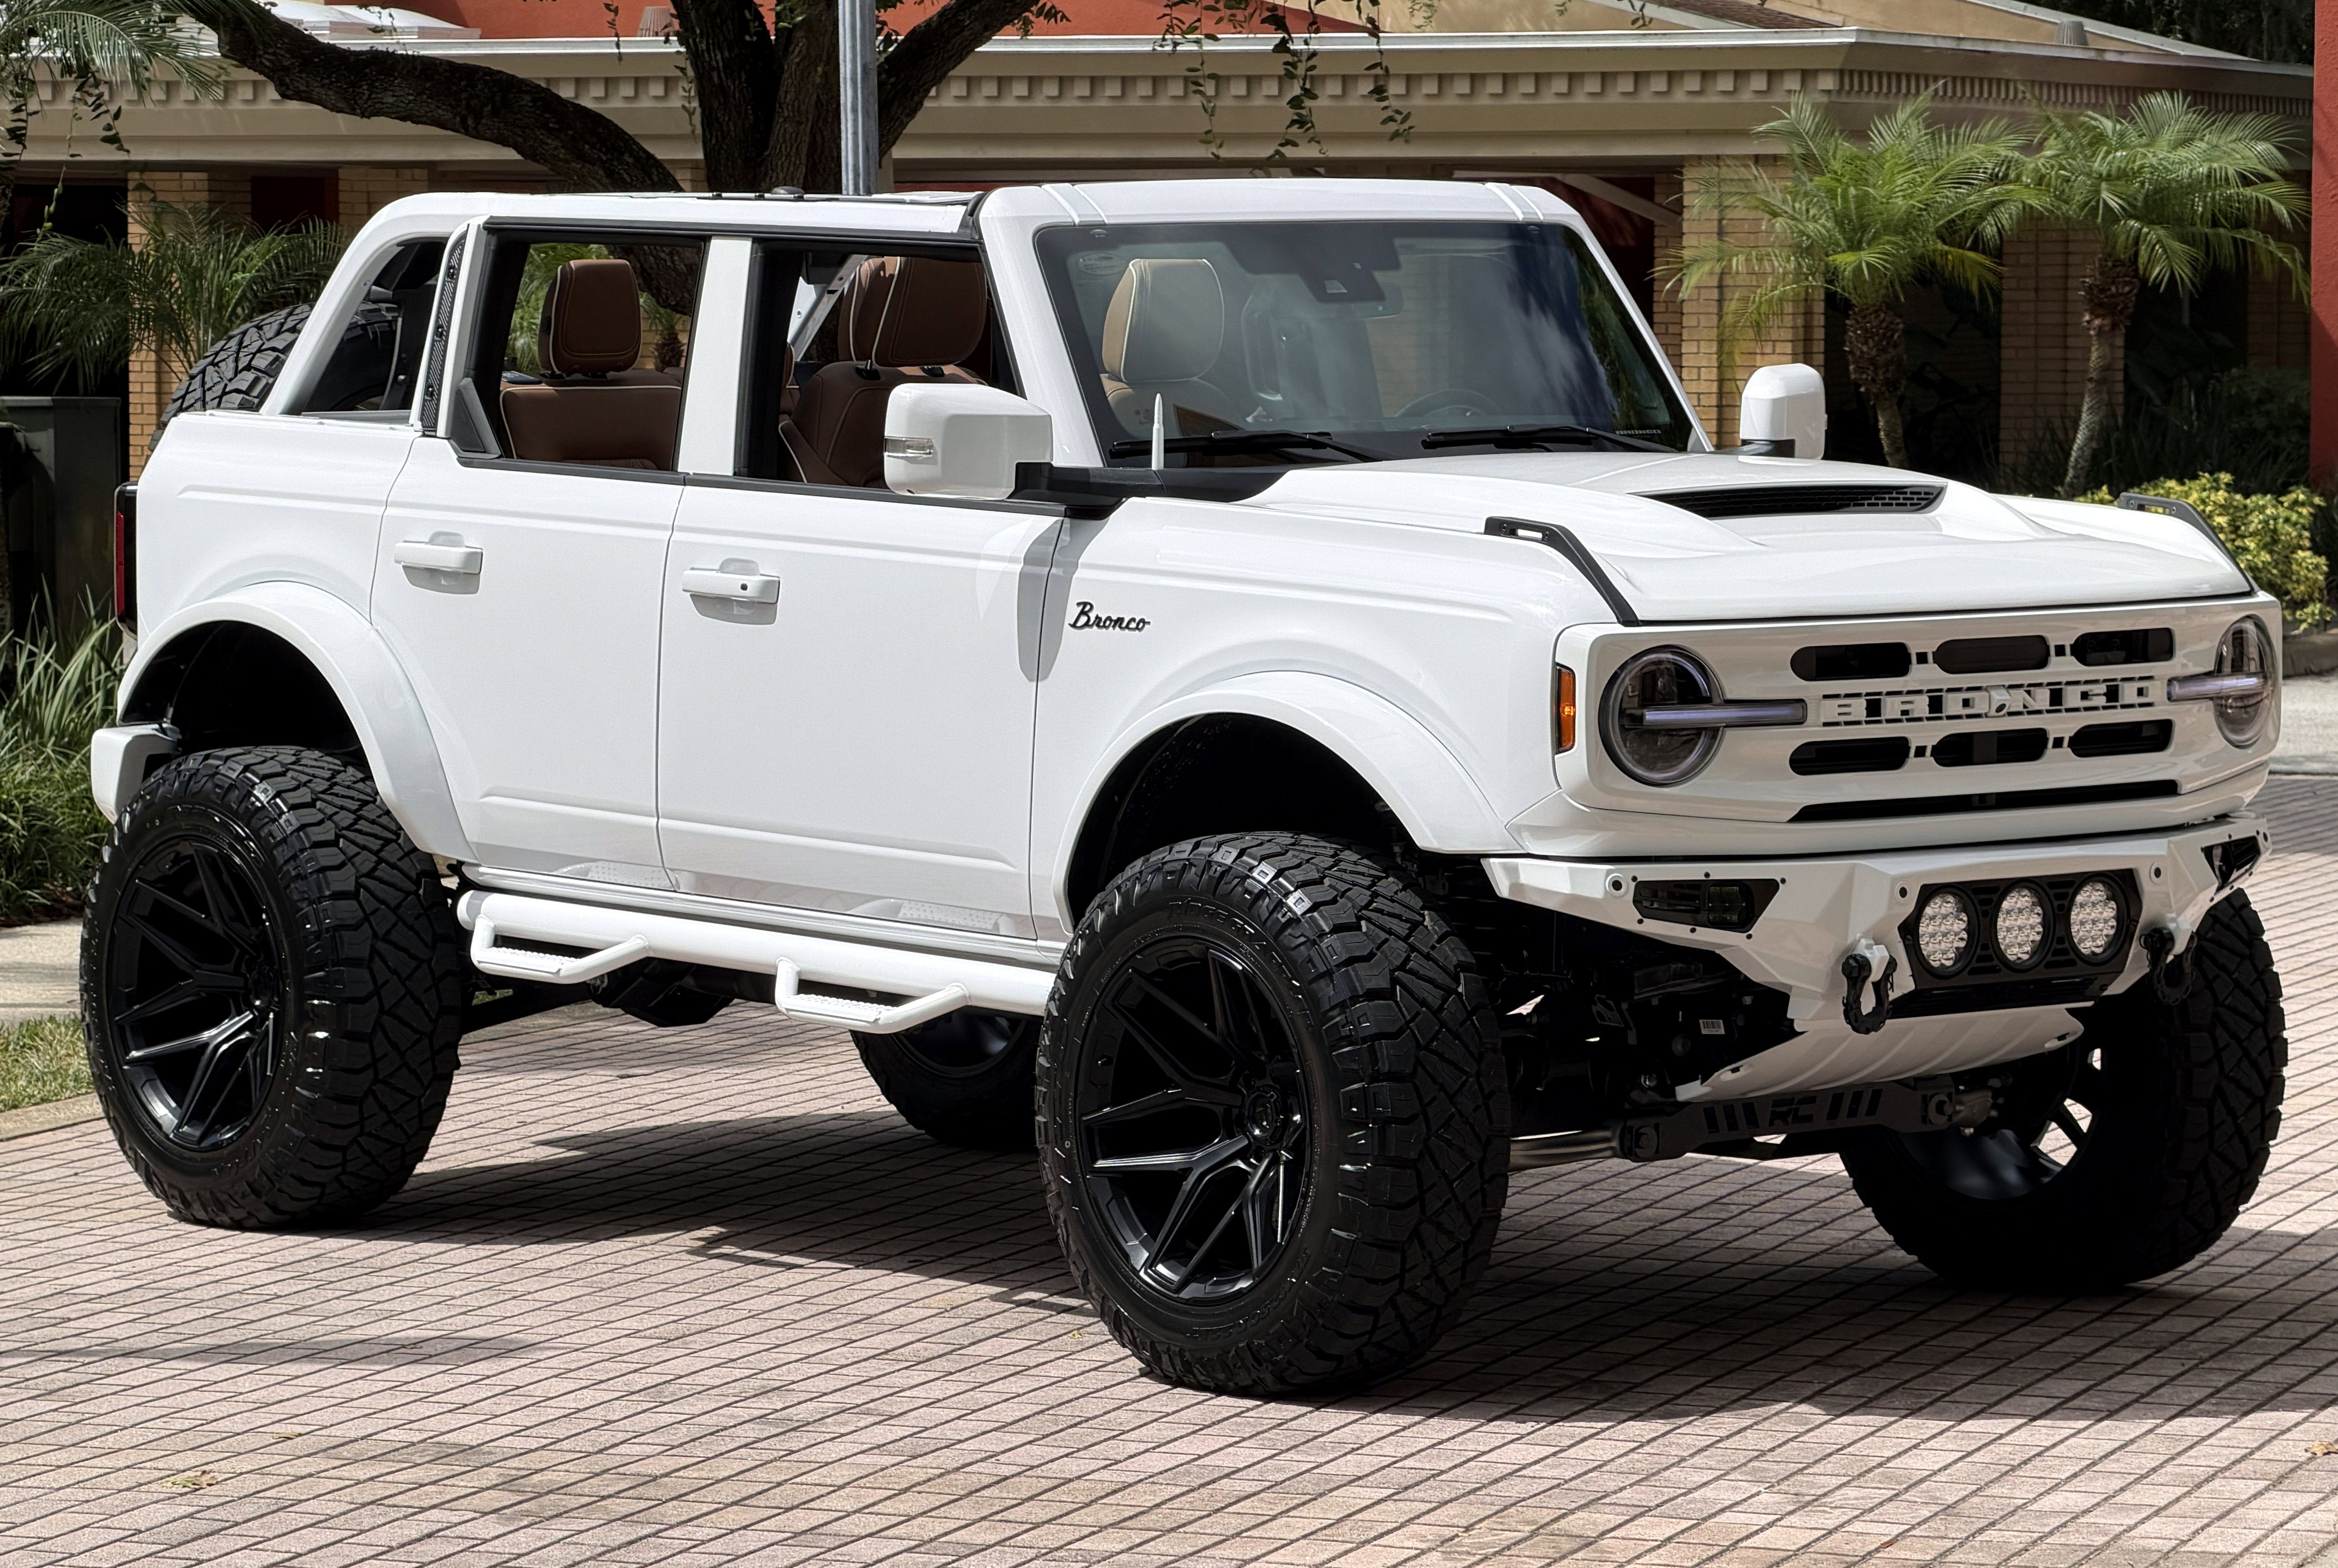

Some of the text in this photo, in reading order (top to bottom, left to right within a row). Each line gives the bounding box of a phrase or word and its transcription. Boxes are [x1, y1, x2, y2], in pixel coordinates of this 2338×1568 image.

[1068, 601, 1151, 632] Bronco
[1820, 681, 2161, 722] BRONCO
[1768, 1095, 1818, 1127] RC
